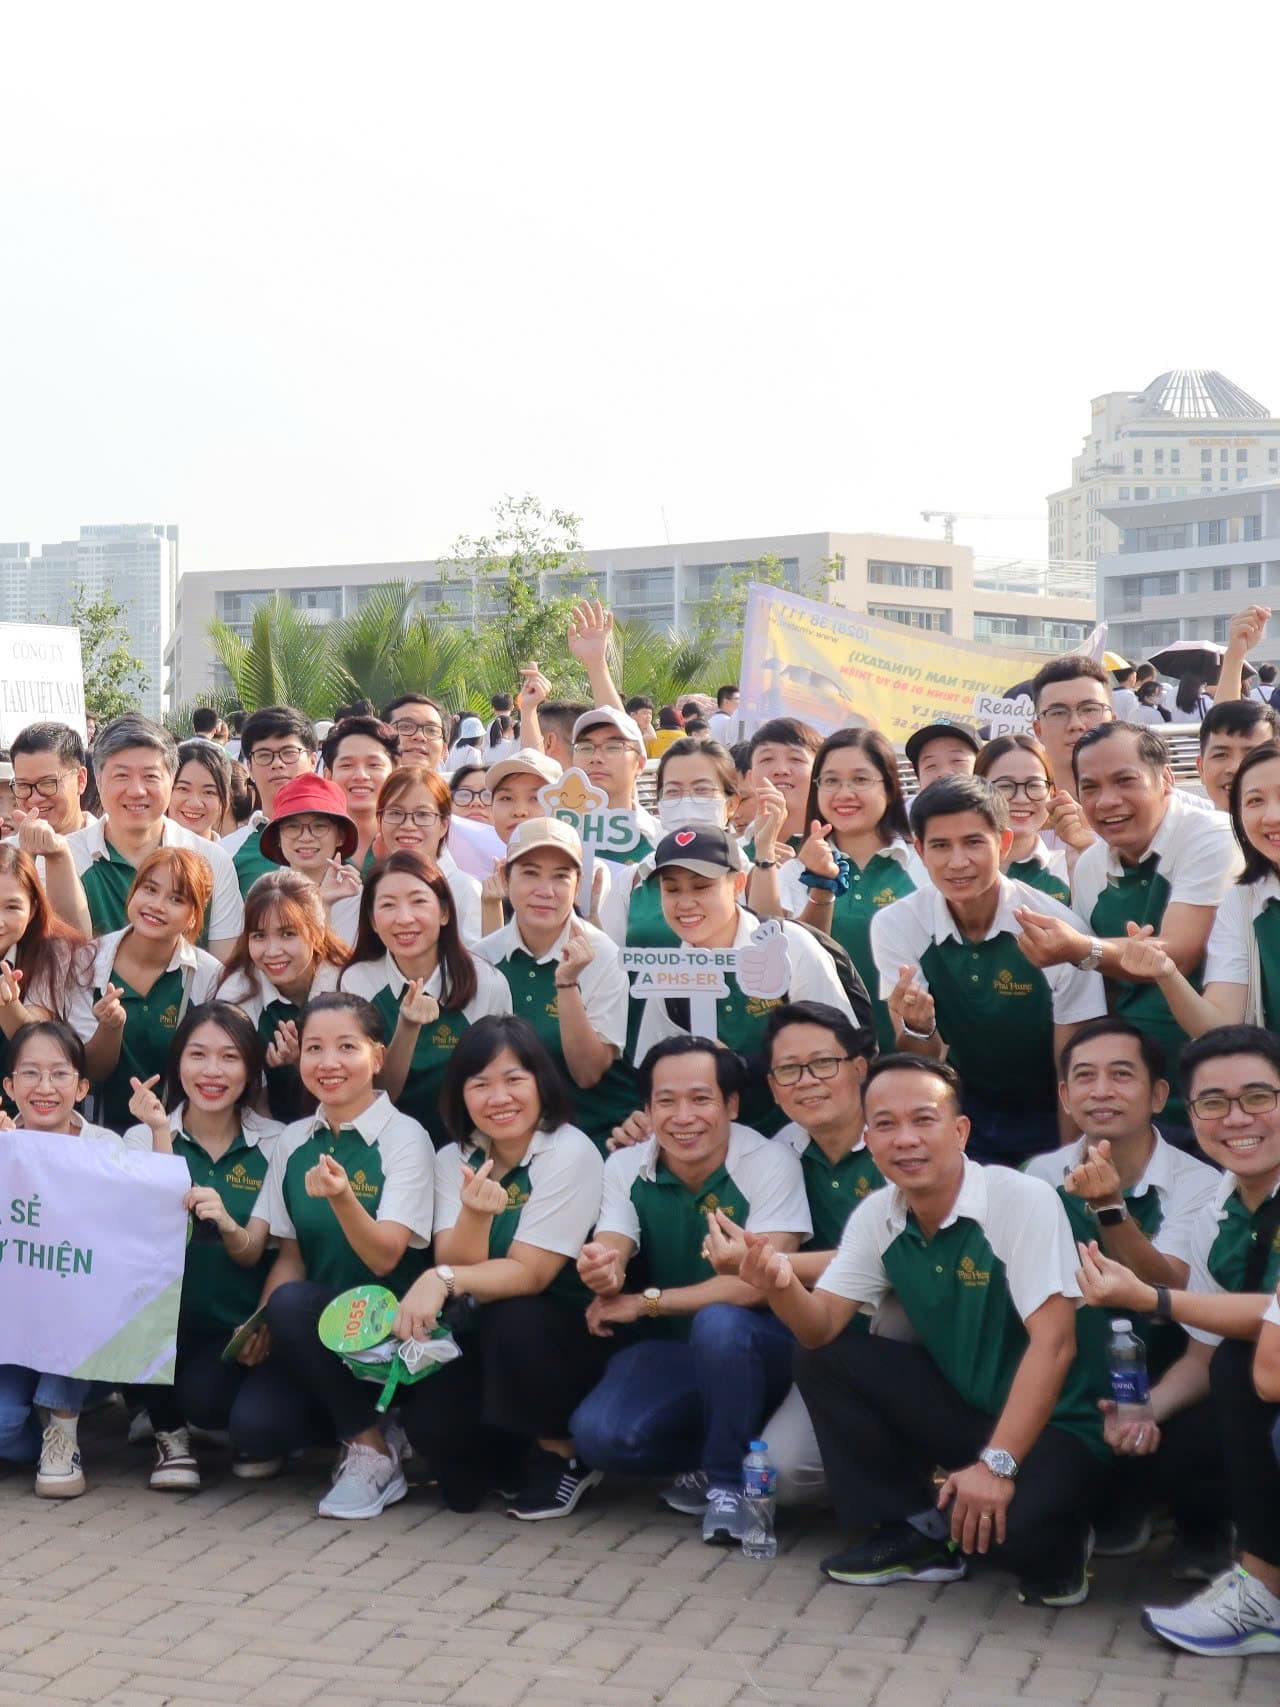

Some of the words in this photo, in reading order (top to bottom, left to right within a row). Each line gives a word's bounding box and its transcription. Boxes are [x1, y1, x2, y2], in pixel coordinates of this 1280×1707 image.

[980, 698, 1035, 723] Ready
[555, 809, 633, 845] PHS
[623, 952, 736, 966] PROUD-TO-BE
[642, 972, 653, 985] A
[657, 972, 718, 985] PHS-ER
[10, 1194, 41, 1227] SẺ
[13, 1240, 93, 1278] THIỆN
[344, 1299, 368, 1339] 1055
